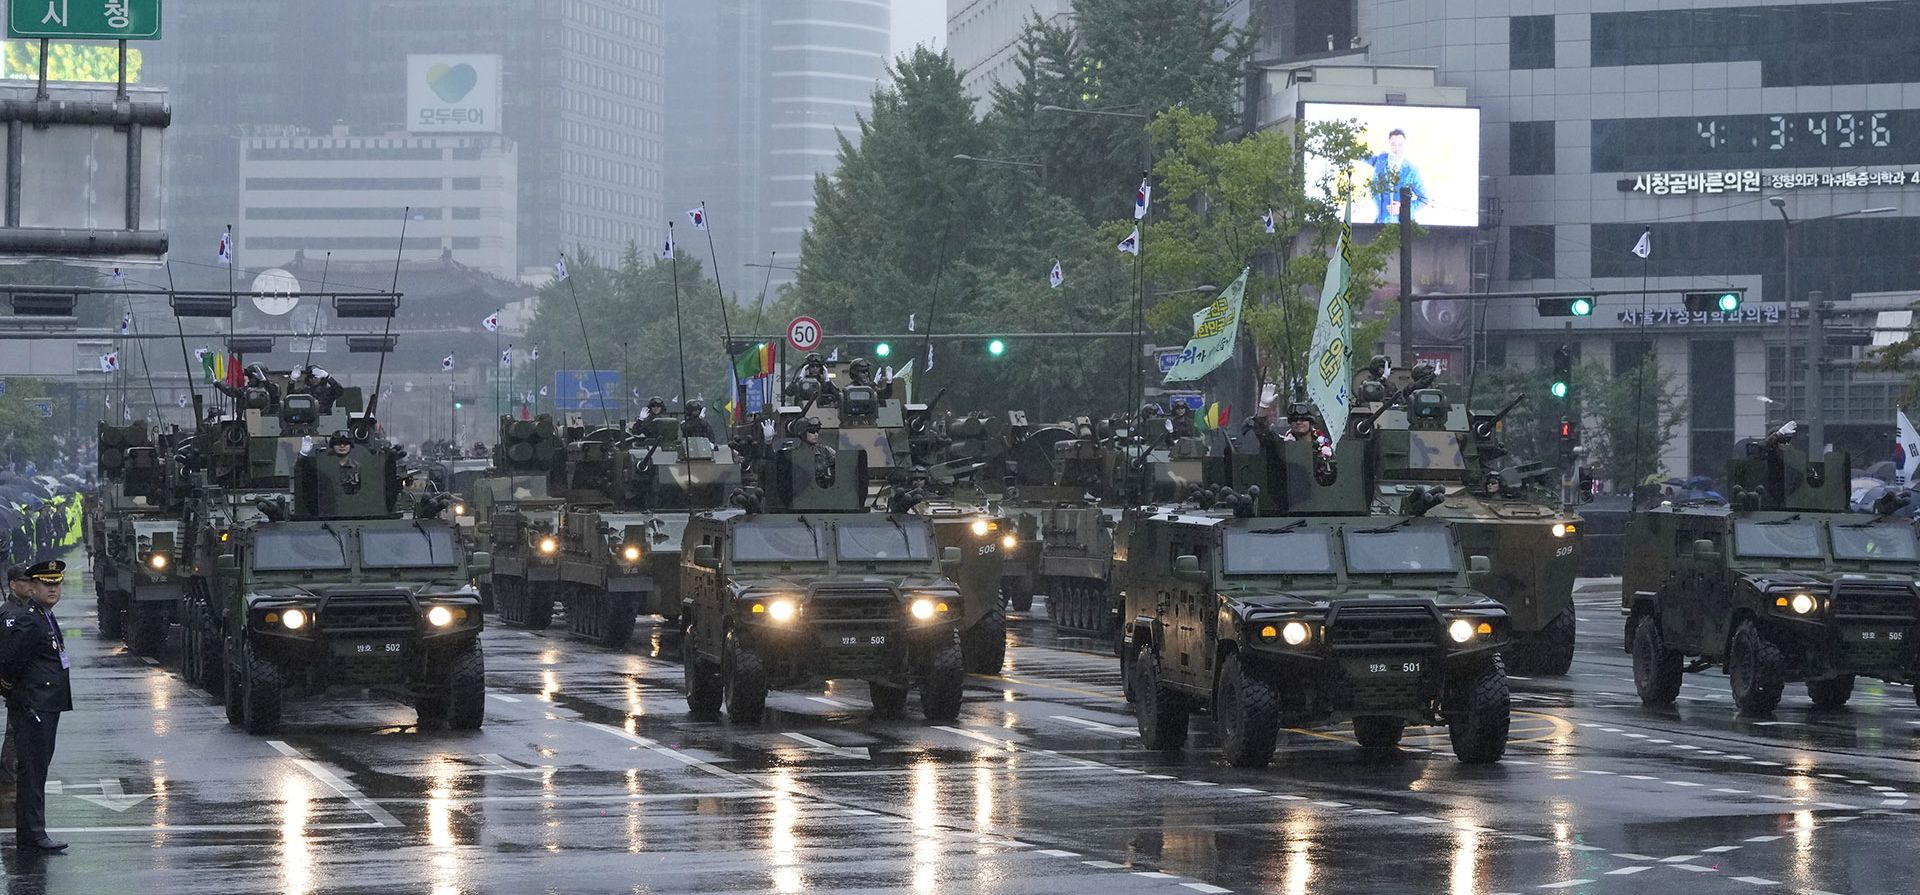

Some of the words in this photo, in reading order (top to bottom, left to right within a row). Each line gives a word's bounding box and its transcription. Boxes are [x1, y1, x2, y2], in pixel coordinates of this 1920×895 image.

[418, 108, 484, 125] 모두투어
[1632, 170, 1761, 195] 시청곧바른의원
[1771, 173, 1819, 189] 정형외과
[1821, 170, 1906, 188] 마취통증의학과
[794, 326, 815, 343] 50
[978, 543, 996, 556] 508
[1556, 545, 1573, 557] 509
[870, 635, 885, 645] 503
[1889, 631, 1903, 641] 505
[385, 643, 401, 652] 502
[1403, 662, 1420, 672] 501
